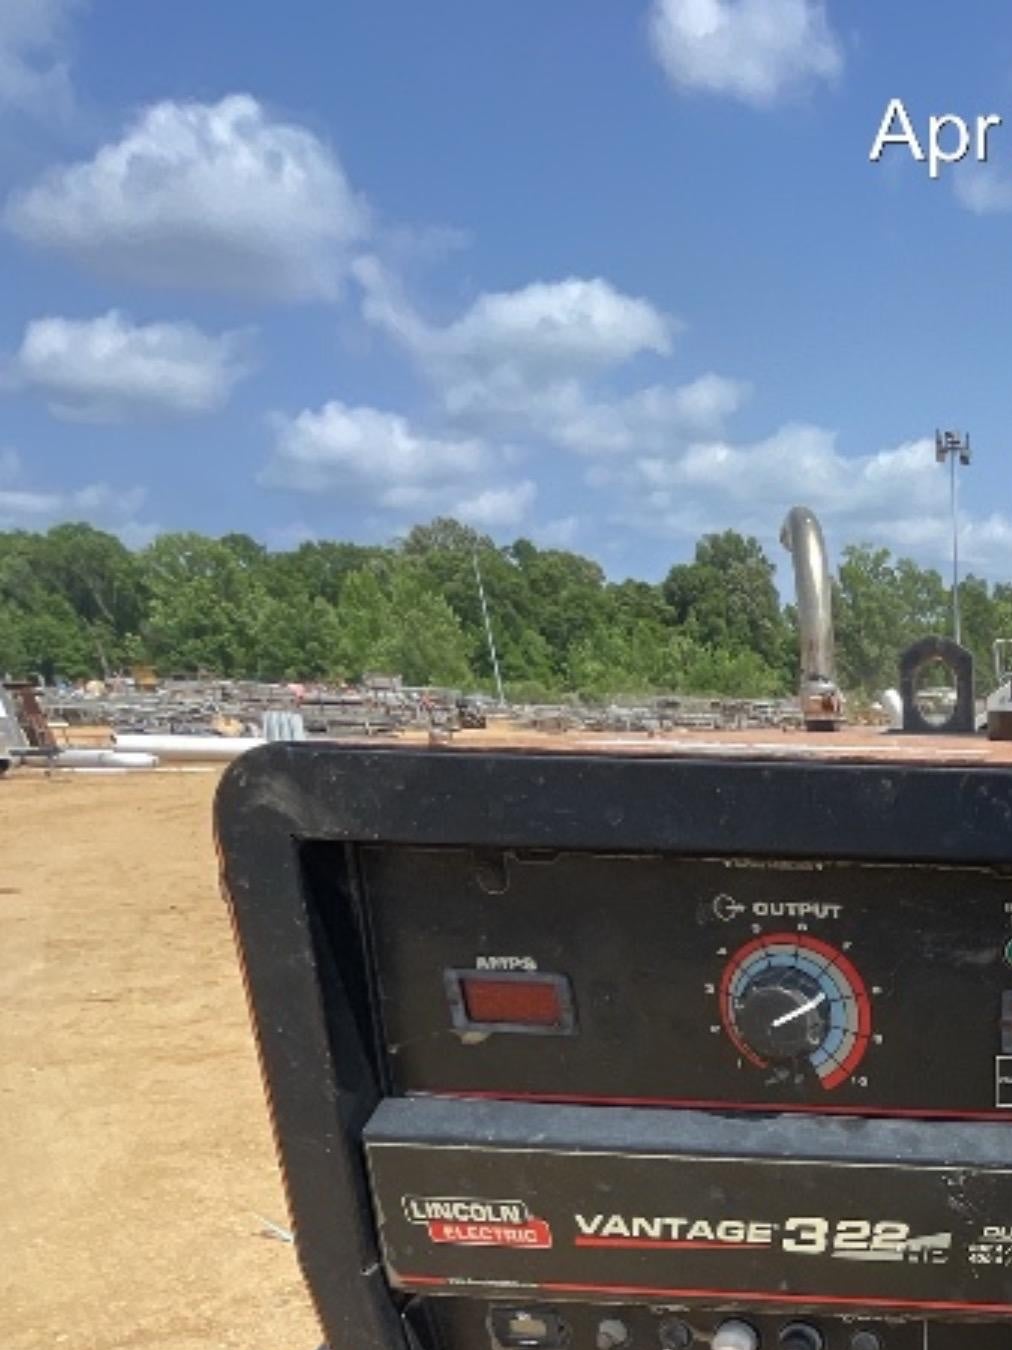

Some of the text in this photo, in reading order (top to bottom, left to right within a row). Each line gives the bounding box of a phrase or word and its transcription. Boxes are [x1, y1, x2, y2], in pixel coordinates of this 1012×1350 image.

[752, 902, 844, 919] OUTPUT
[411, 1200, 522, 1222] LINCOLN
[443, 1225, 538, 1243] ELECTRIC
[574, 1213, 910, 1254] VANTAGE 322
